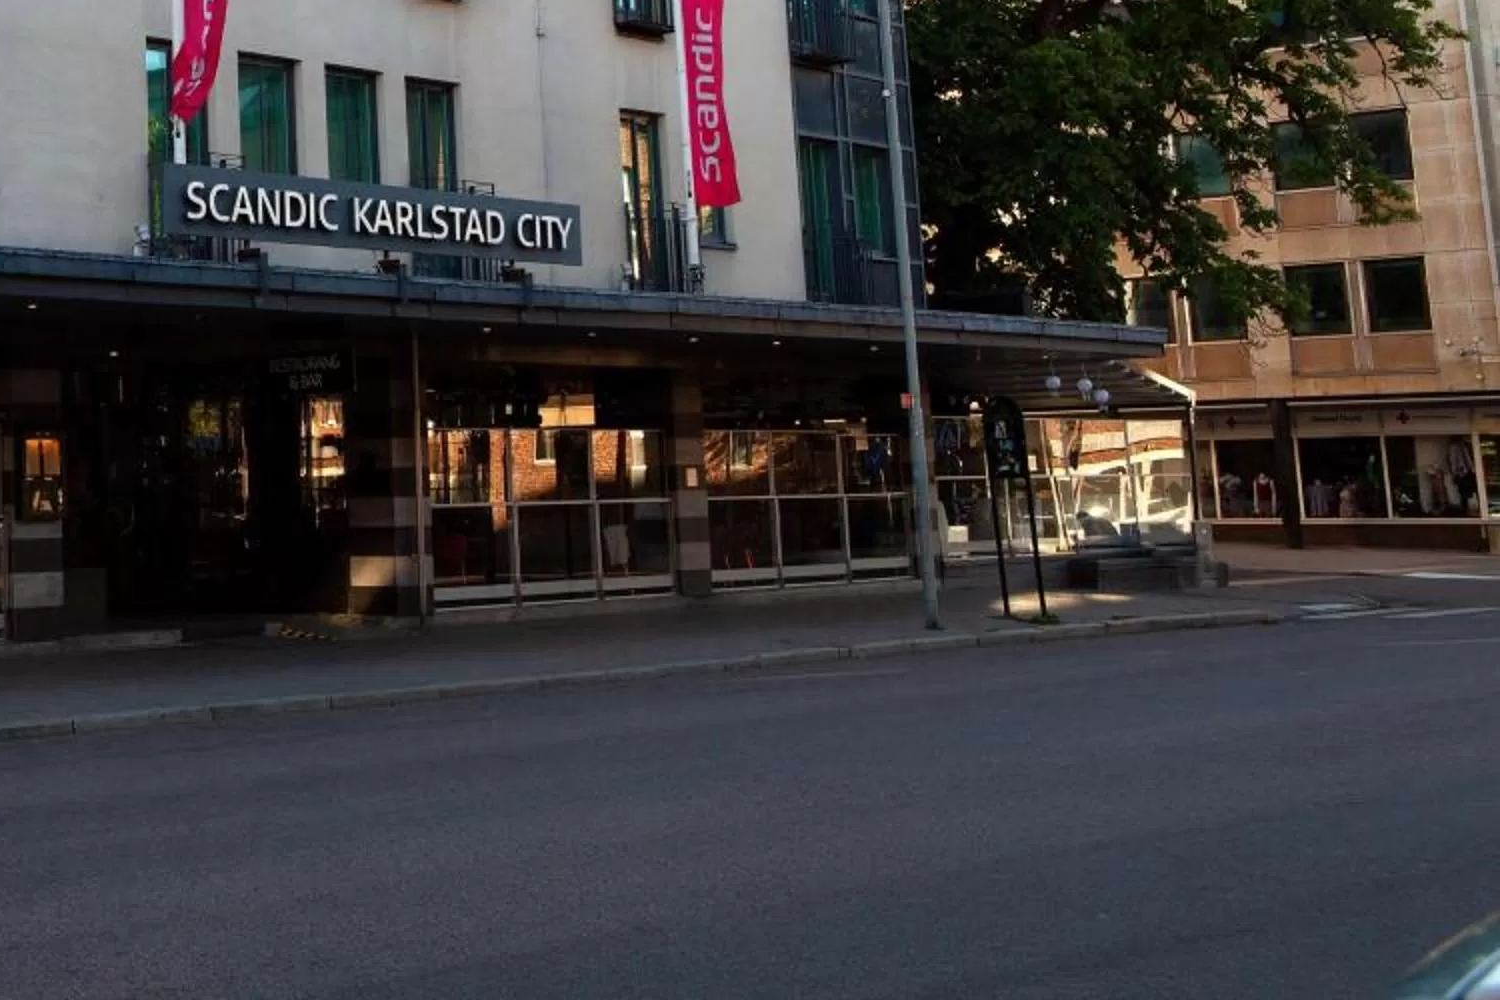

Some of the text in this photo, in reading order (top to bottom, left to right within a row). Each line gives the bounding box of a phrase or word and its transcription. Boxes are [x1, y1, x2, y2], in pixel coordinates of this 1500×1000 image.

[186, 181, 572, 249] SCANDIC KARLSTAD CITY
